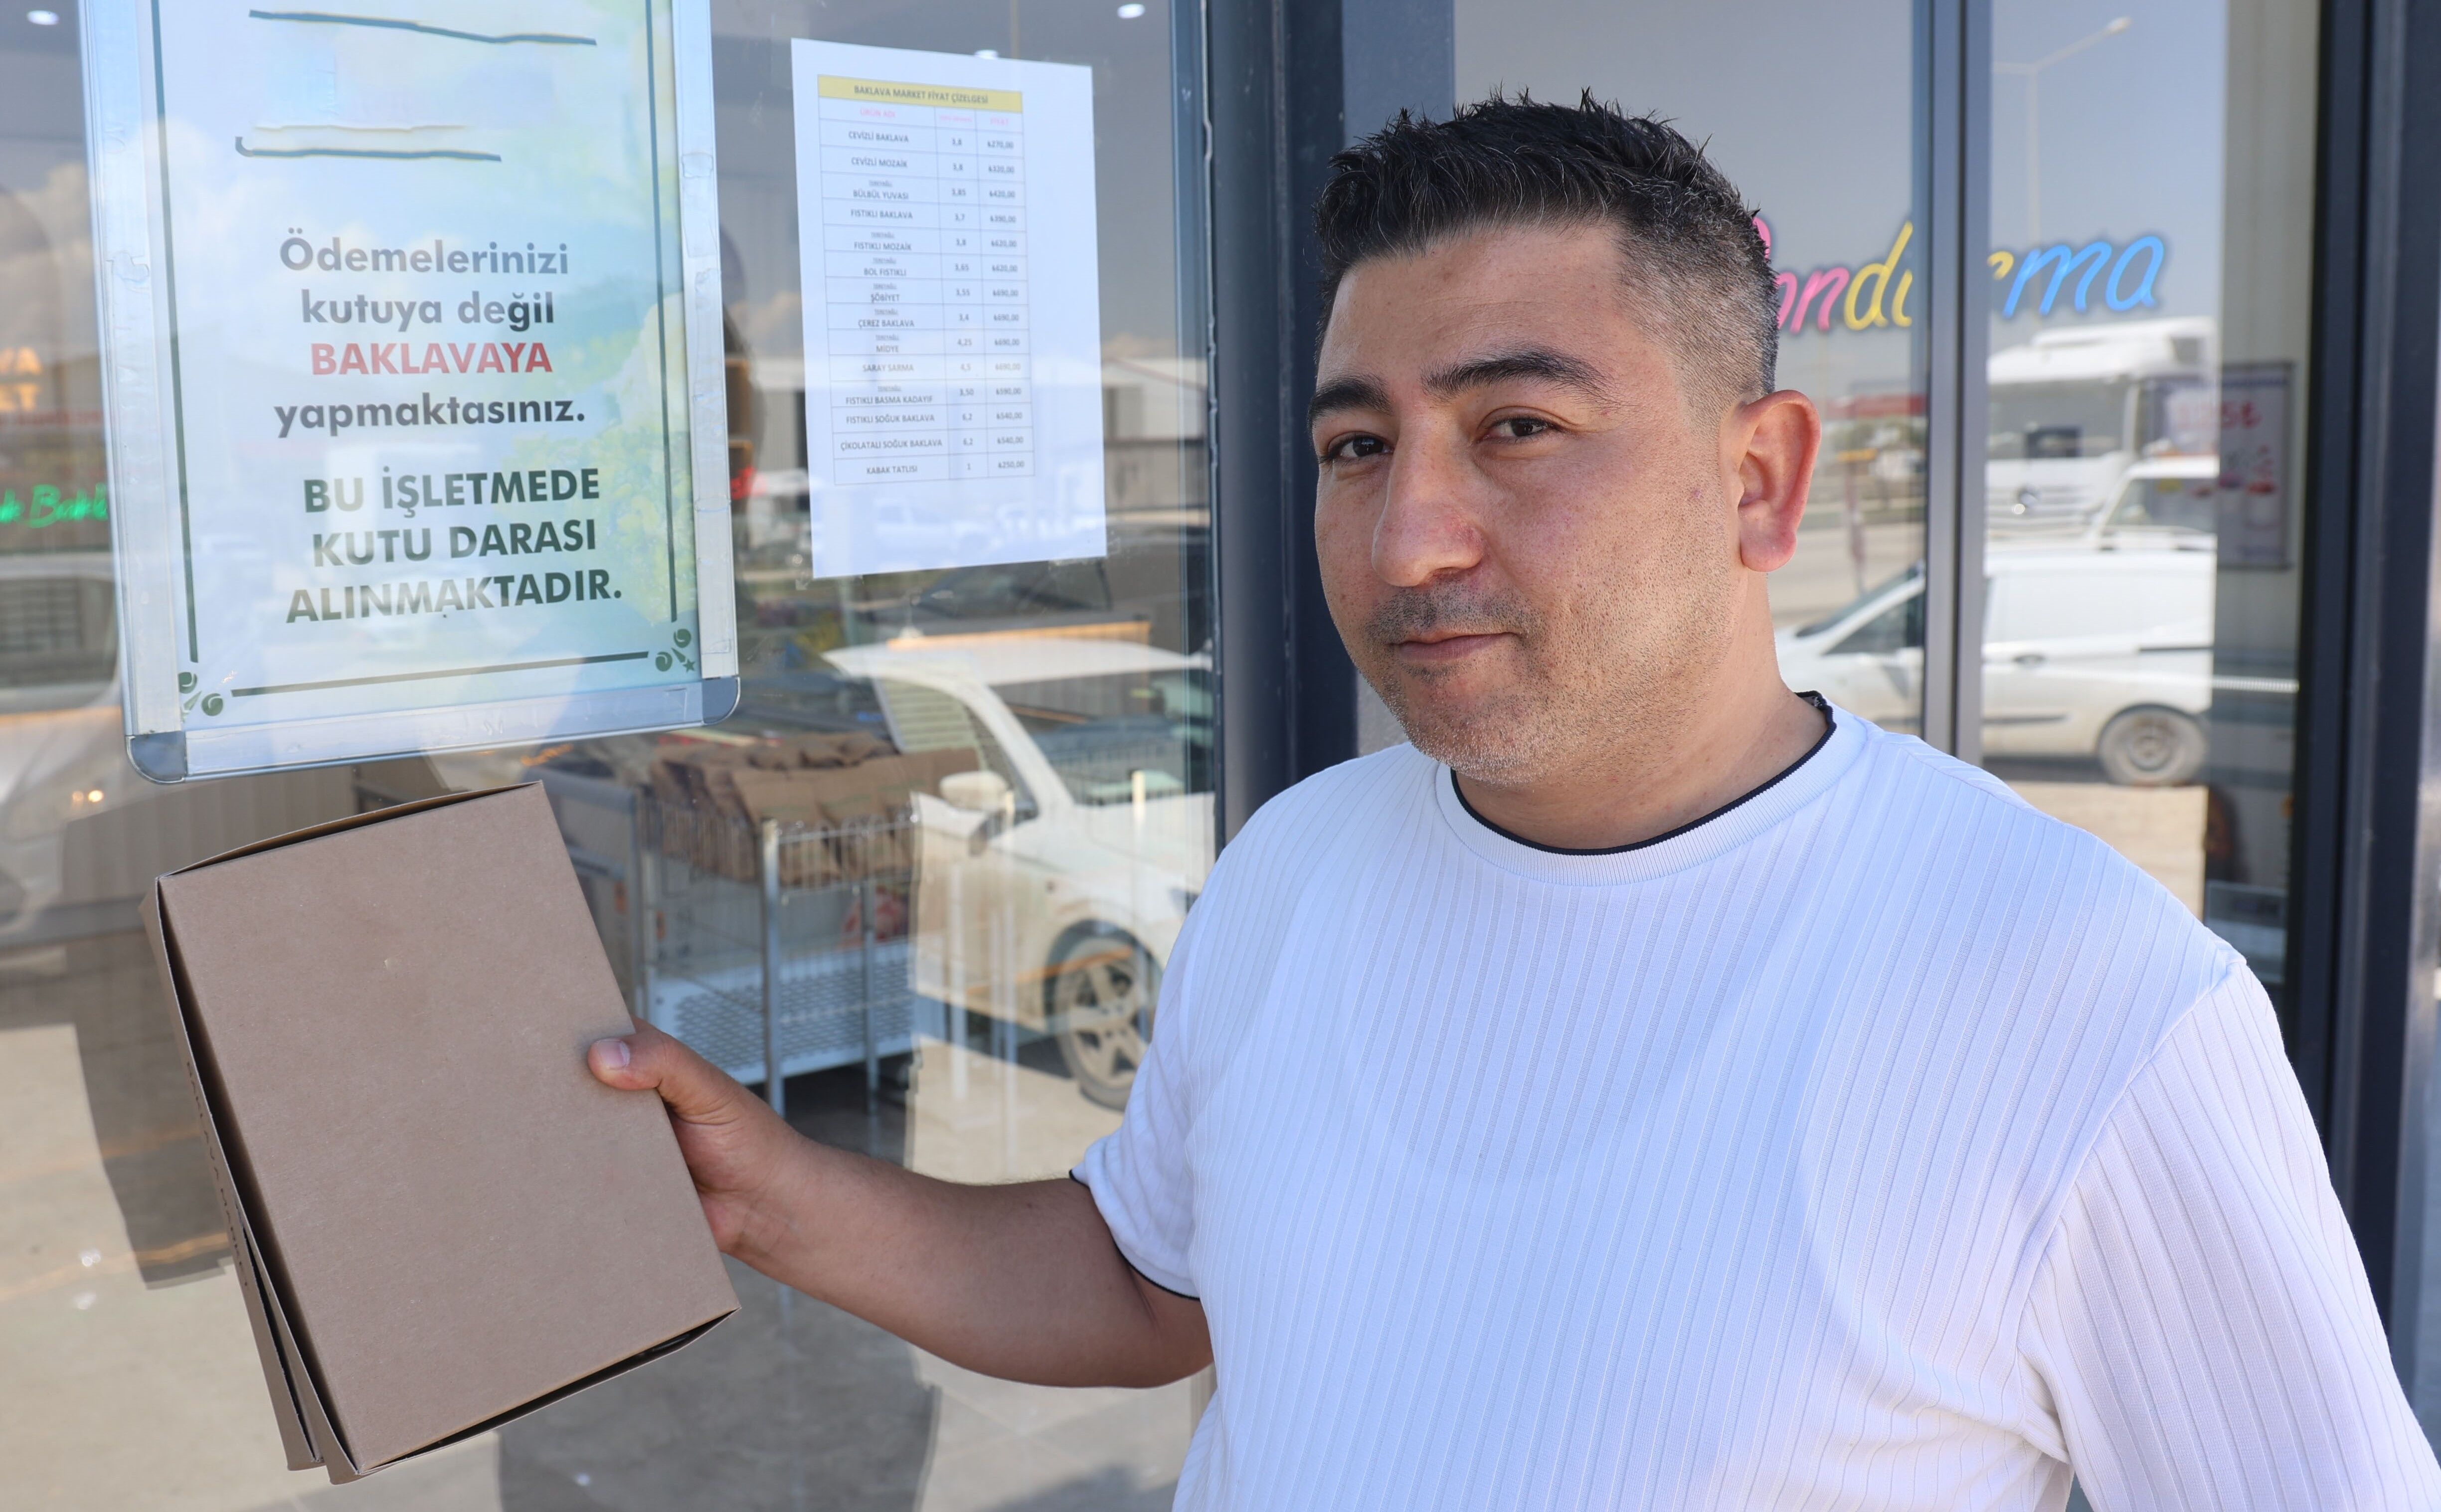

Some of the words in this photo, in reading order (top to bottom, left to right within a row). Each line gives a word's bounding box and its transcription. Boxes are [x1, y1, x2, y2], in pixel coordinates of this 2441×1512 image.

[854, 85, 891, 96] BAKLAVA
[893, 89, 926, 99] MARKET
[928, 91, 949, 101] FİYAT
[951, 93, 988, 104] ÇİZELGESİ
[849, 131, 873, 141] CEVİZLİ
[876, 133, 908, 142] BAKLAVA
[851, 157, 877, 166] CEVİZLİ
[878, 159, 907, 168] MOZAİK
[853, 189, 880, 199] BÜLBÜL
[882, 191, 908, 201] YUVASI
[851, 209, 877, 218] FISTIKLI
[879, 210, 913, 219] BAKLAVA
[279, 227, 568, 276] Ödemelerinizi
[854, 242, 881, 251] FISTIKLI
[870, 292, 899, 304] ŞÖBİYET
[302, 288, 442, 331] kutuya
[457, 291, 553, 331] değil
[858, 320, 879, 330] ÇEREZ
[311, 342, 552, 375] BAKLAVAYA
[863, 364, 886, 372] SARAY
[274, 393, 585, 438] yapmaktasınız.
[875, 414, 900, 423] SOĞUK
[841, 441, 881, 451] ÇİKOLATALI
[883, 439, 908, 449] SOĞUK
[304, 478, 363, 513] BU
[382, 466, 600, 517] İŞLETMEDE
[314, 527, 431, 567] KUTU
[450, 518, 596, 557] DARASI
[286, 569, 622, 623] ALINMAKTADIR.
